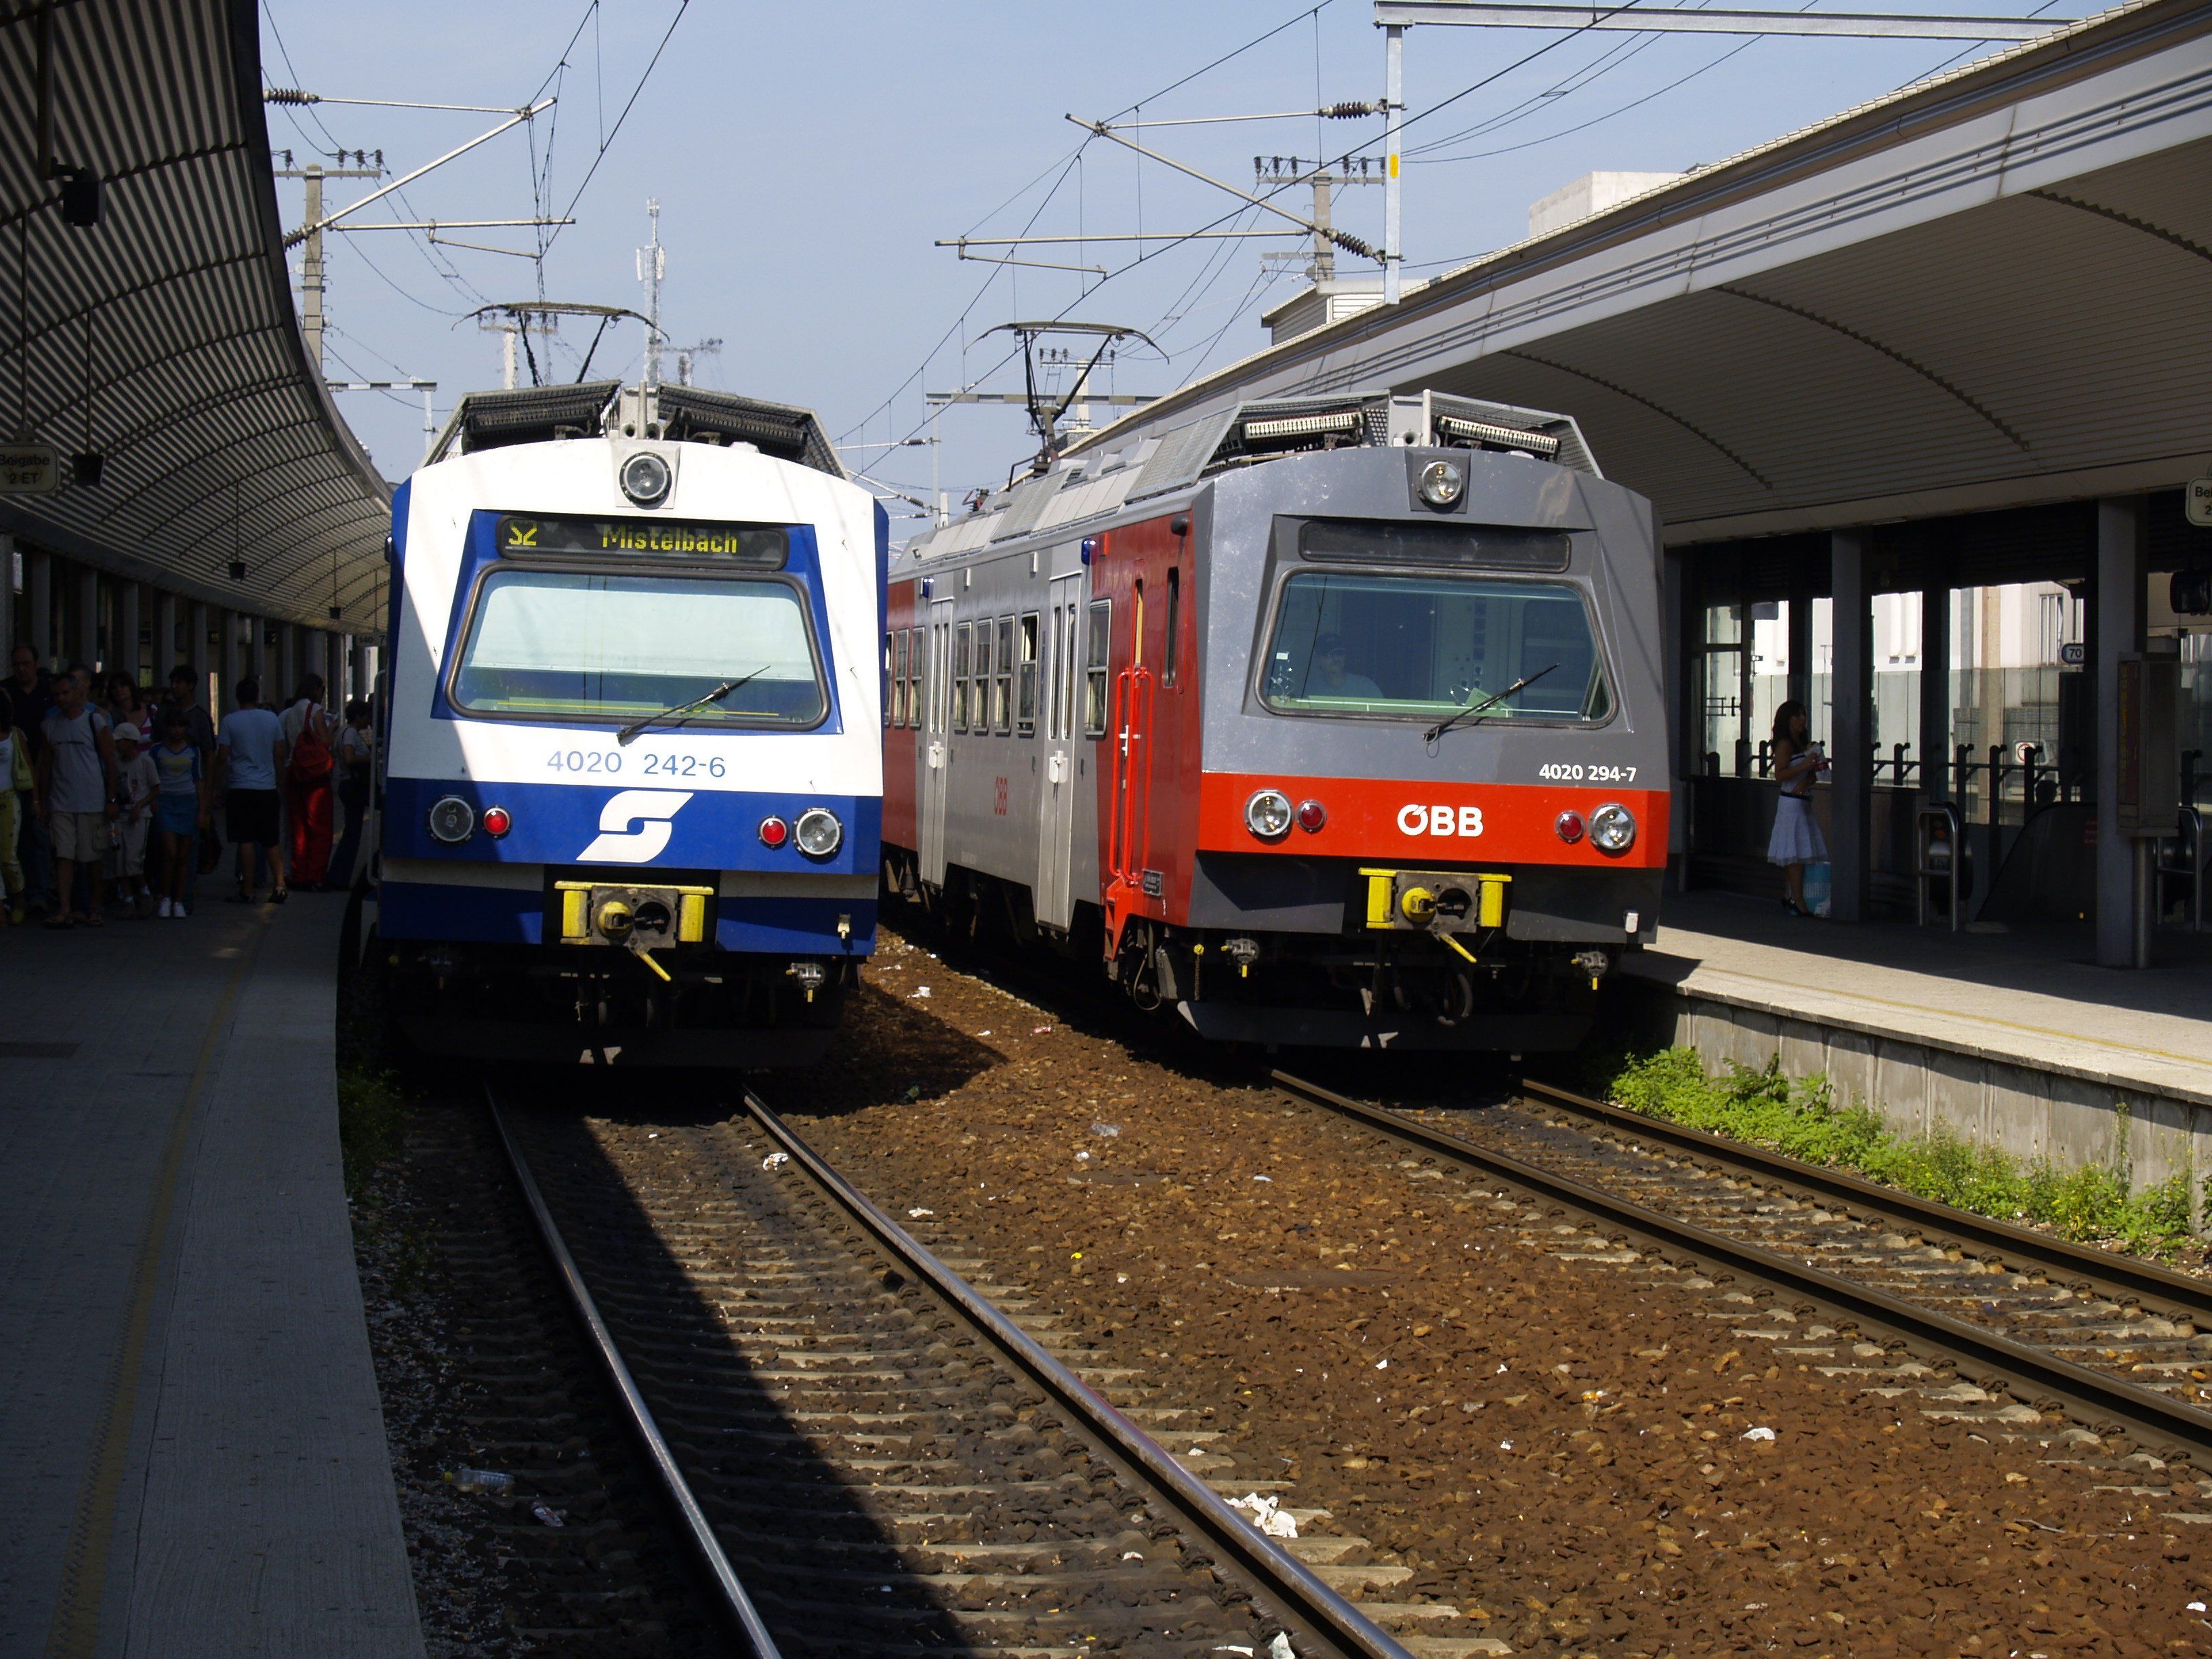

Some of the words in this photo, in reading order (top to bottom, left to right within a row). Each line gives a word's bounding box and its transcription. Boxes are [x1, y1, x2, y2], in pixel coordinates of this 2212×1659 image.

[9, 473, 16, 484] 2
[22, 472, 39, 484] ET
[602, 525, 737, 554] Mistelbach
[2069, 649, 2082, 658] 70
[547, 750, 622, 773] 4020
[644, 754, 726, 778] 242-6
[1538, 764, 1584, 780] 4020
[1587, 764, 1637, 782] 294-7
[1397, 804, 1483, 838] ÖBB
